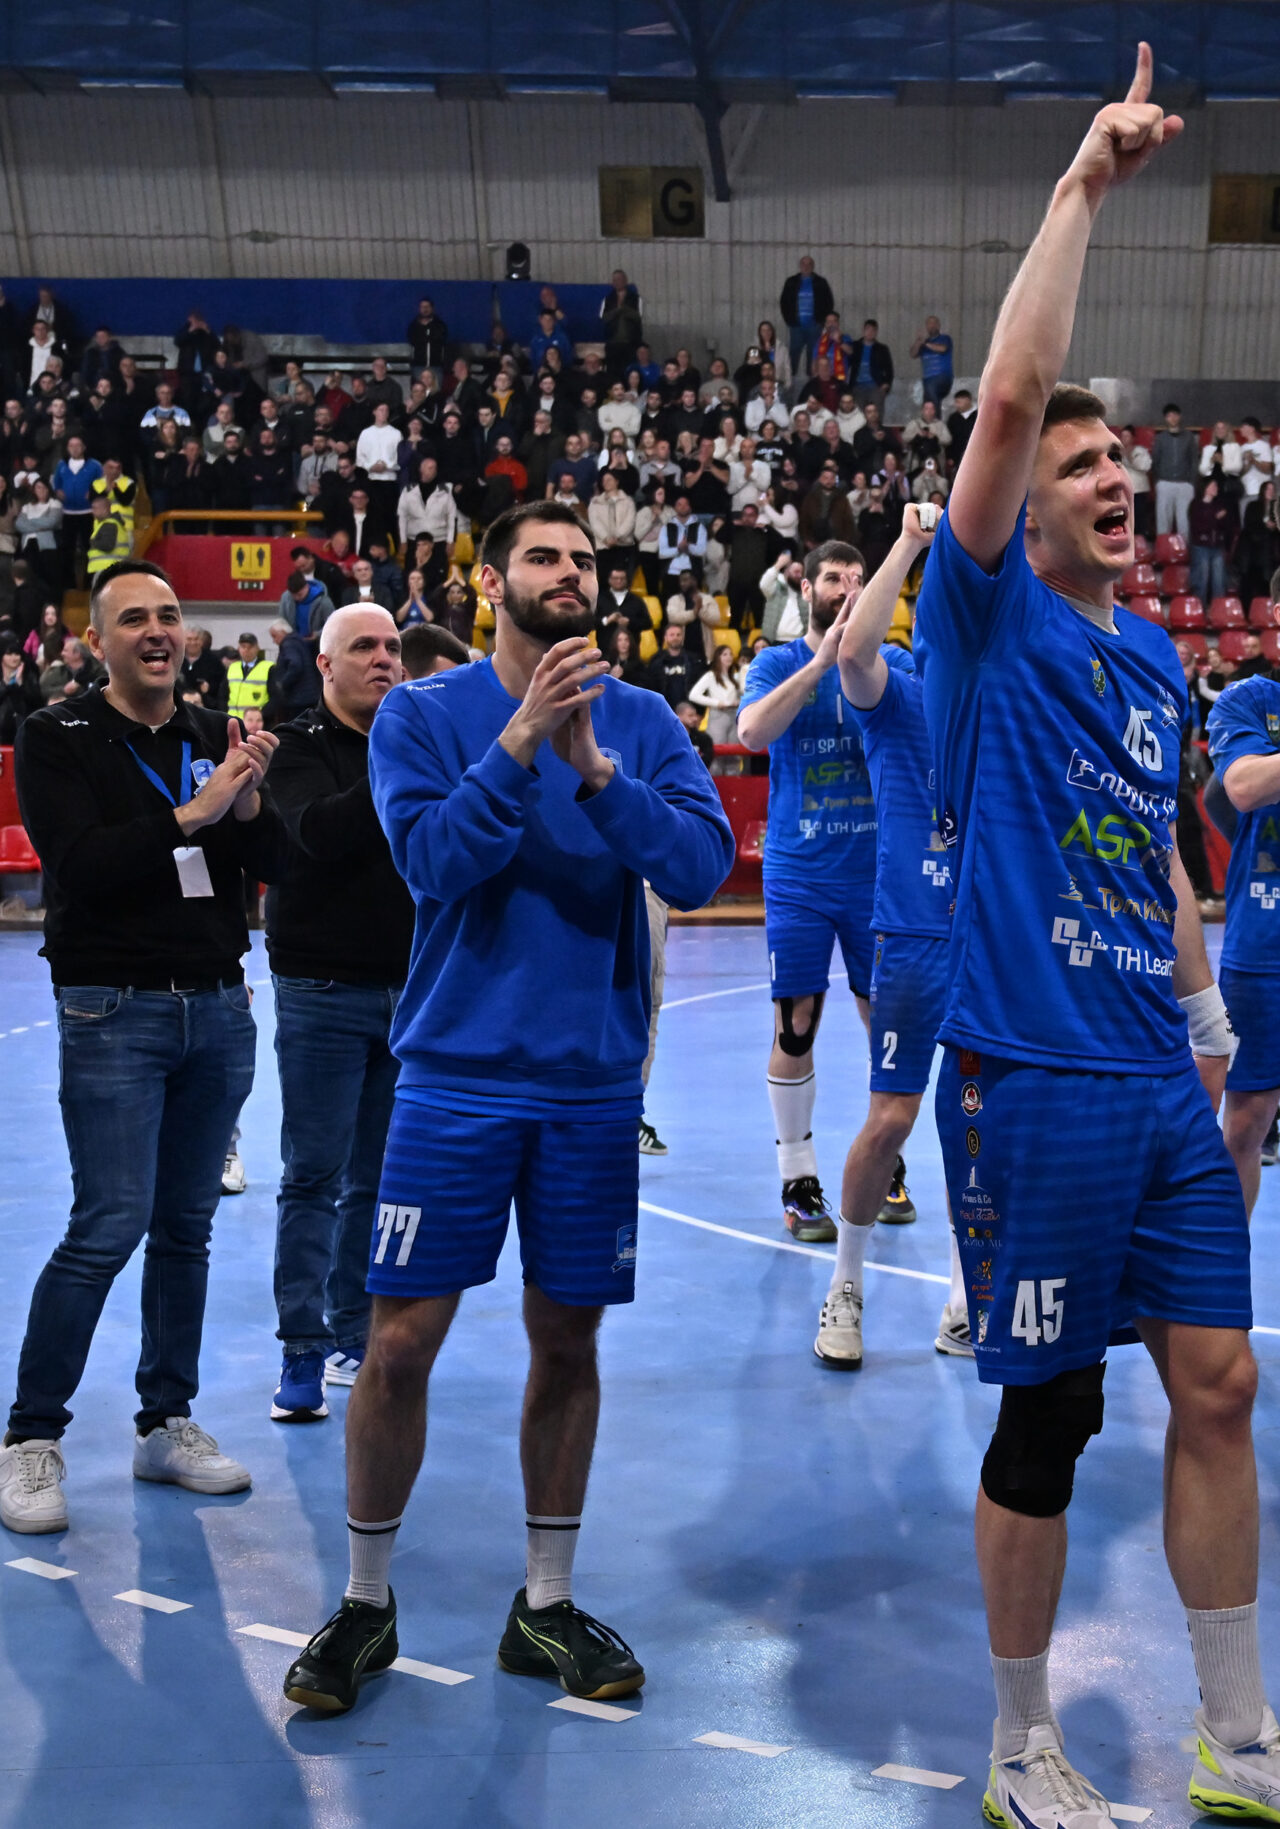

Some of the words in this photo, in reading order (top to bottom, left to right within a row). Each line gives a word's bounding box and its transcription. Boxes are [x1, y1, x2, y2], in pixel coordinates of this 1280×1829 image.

[661, 178, 696, 226] G
[1122, 705, 1163, 772] 45
[1113, 945, 1141, 972] TH
[881, 1030, 898, 1070] 2
[374, 1203, 422, 1266] 77
[1011, 1277, 1067, 1346] 45
